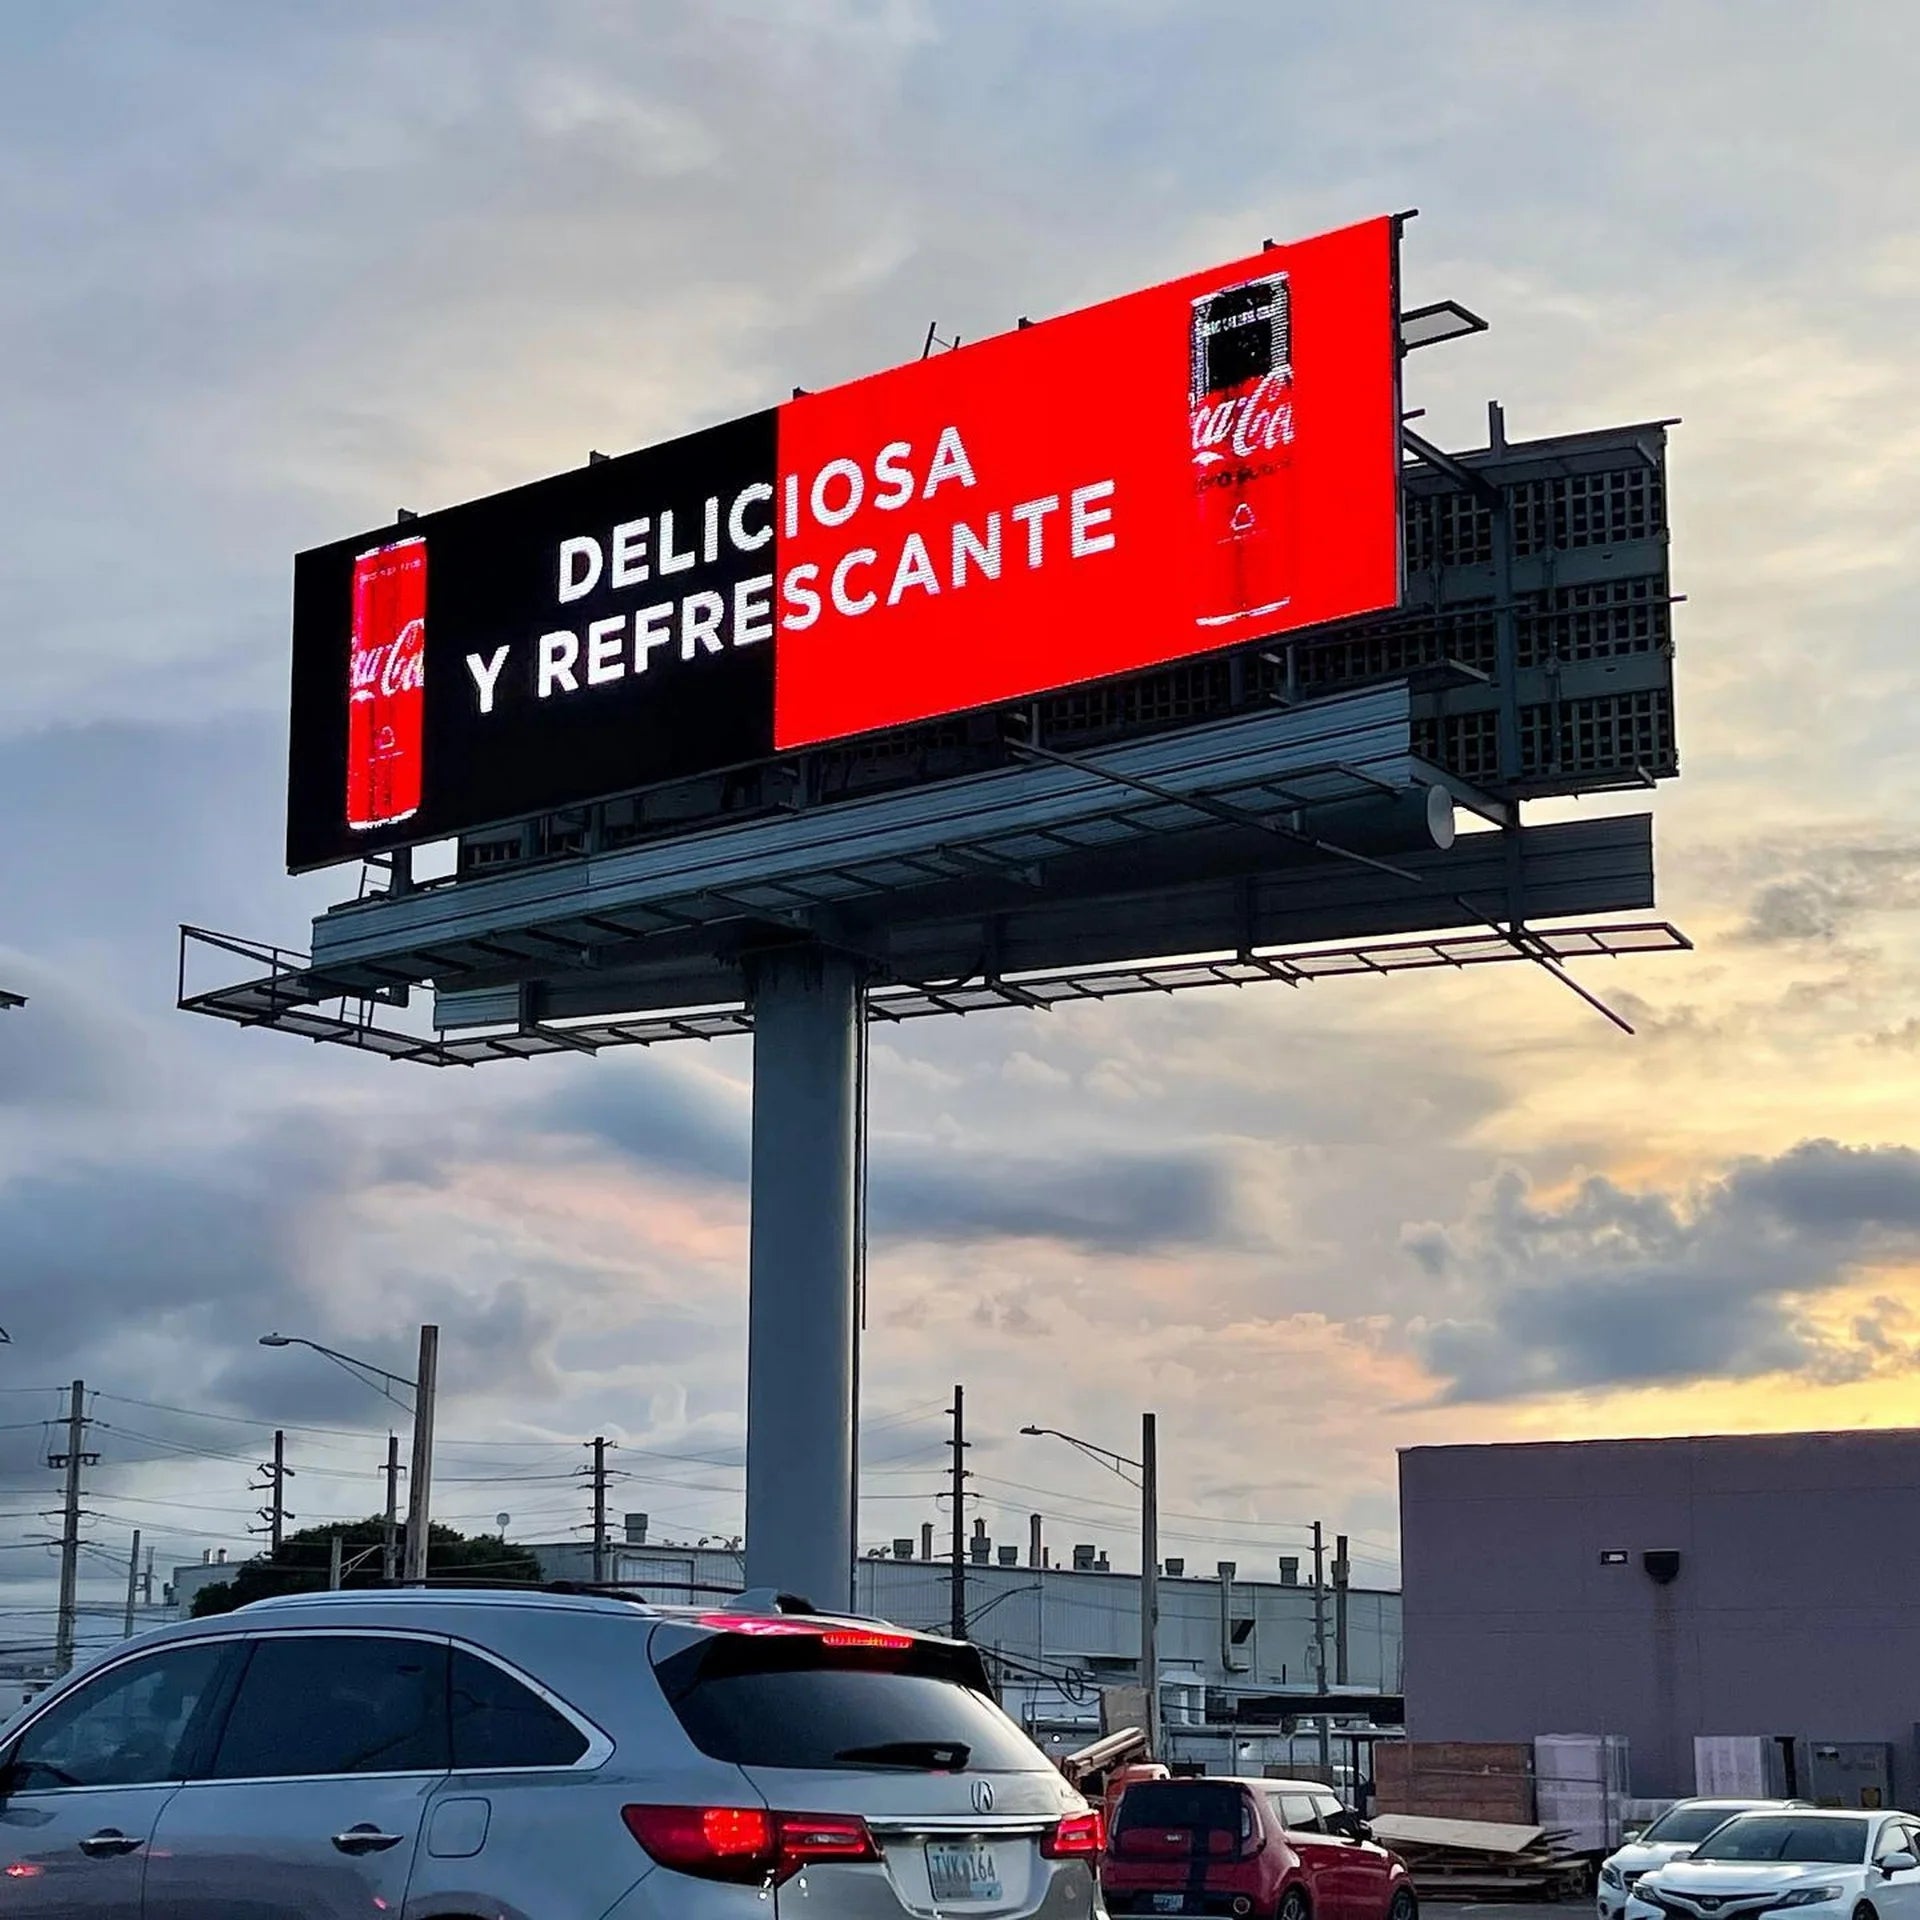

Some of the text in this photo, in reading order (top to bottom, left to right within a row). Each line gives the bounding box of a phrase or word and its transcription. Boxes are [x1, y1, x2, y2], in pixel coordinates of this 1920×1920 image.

[466, 479, 1116, 714] Y REFRESCANTE
[558, 426, 978, 604] DELICIOSA
